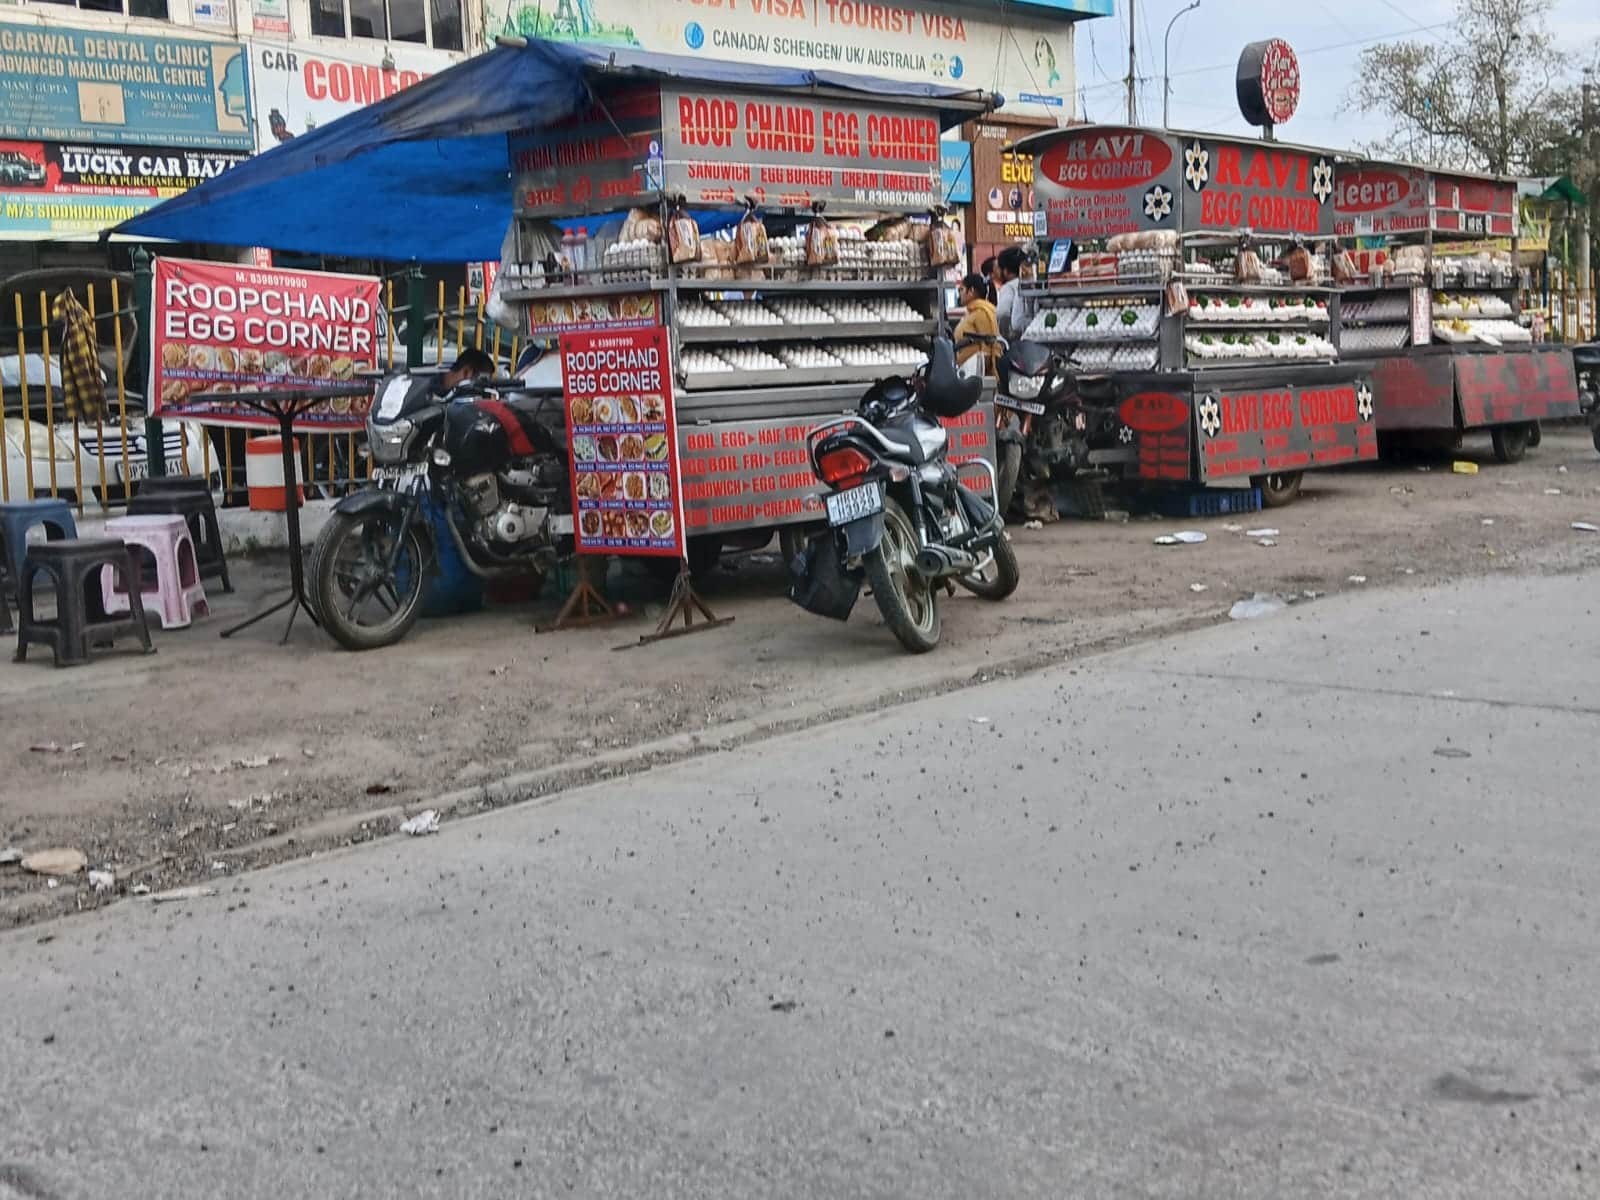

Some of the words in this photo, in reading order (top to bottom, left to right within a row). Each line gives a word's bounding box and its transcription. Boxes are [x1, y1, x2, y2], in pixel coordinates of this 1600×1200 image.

[825, 0, 916, 35] TOURIST
[921, 15, 967, 42] VISA
[0, 29, 79, 57] GARWAL
[84, 37, 149, 62] DENTAL
[155, 43, 209, 67] CLINIC
[262, 50, 298, 72] CAR
[867, 49, 926, 71] AUSTRALIA
[68, 59, 160, 84] MAXILLOFACIAL
[163, 66, 207, 88] CENTRE
[679, 95, 737, 147] ROOP
[745, 102, 814, 153] CHAND
[823, 111, 860, 158] EGG
[867, 113, 937, 163] CORNER
[1066, 134, 1145, 161] RAVI
[62, 152, 132, 175] LUCKY
[138, 156, 182, 177] CAR
[687, 163, 751, 182] SANDWICH
[761, 167, 784, 183] EGG
[786, 167, 833, 187] BURGER
[841, 170, 879, 189] CREAM
[1002, 161, 1034, 183] EDU
[1058, 163, 1088, 182] EGG
[1091, 159, 1152, 179] CORNER
[1215, 145, 1310, 192] RAVI
[1200, 189, 1243, 228] EGG
[1247, 193, 1320, 234] CORNER
[166, 279, 370, 324] ROOPCHAND
[165, 310, 236, 342] EGG
[244, 318, 372, 353] CORNER
[566, 347, 659, 371] ROOPCHAND
[568, 373, 597, 394] EGG
[600, 370, 661, 392] CORNER
[1222, 394, 1259, 434] RAVI
[1261, 390, 1294, 430] EGG
[1300, 387, 1358, 427] CORNER
[687, 432, 715, 451] BOIL
[721, 431, 747, 449] EGG
[784, 425, 807, 442] FRY
[708, 455, 738, 473] BOIL
[774, 449, 797, 467] EGG
[684, 479, 742, 500] SANDWICH
[752, 475, 776, 494] EGG
[762, 497, 803, 517] CREAM
